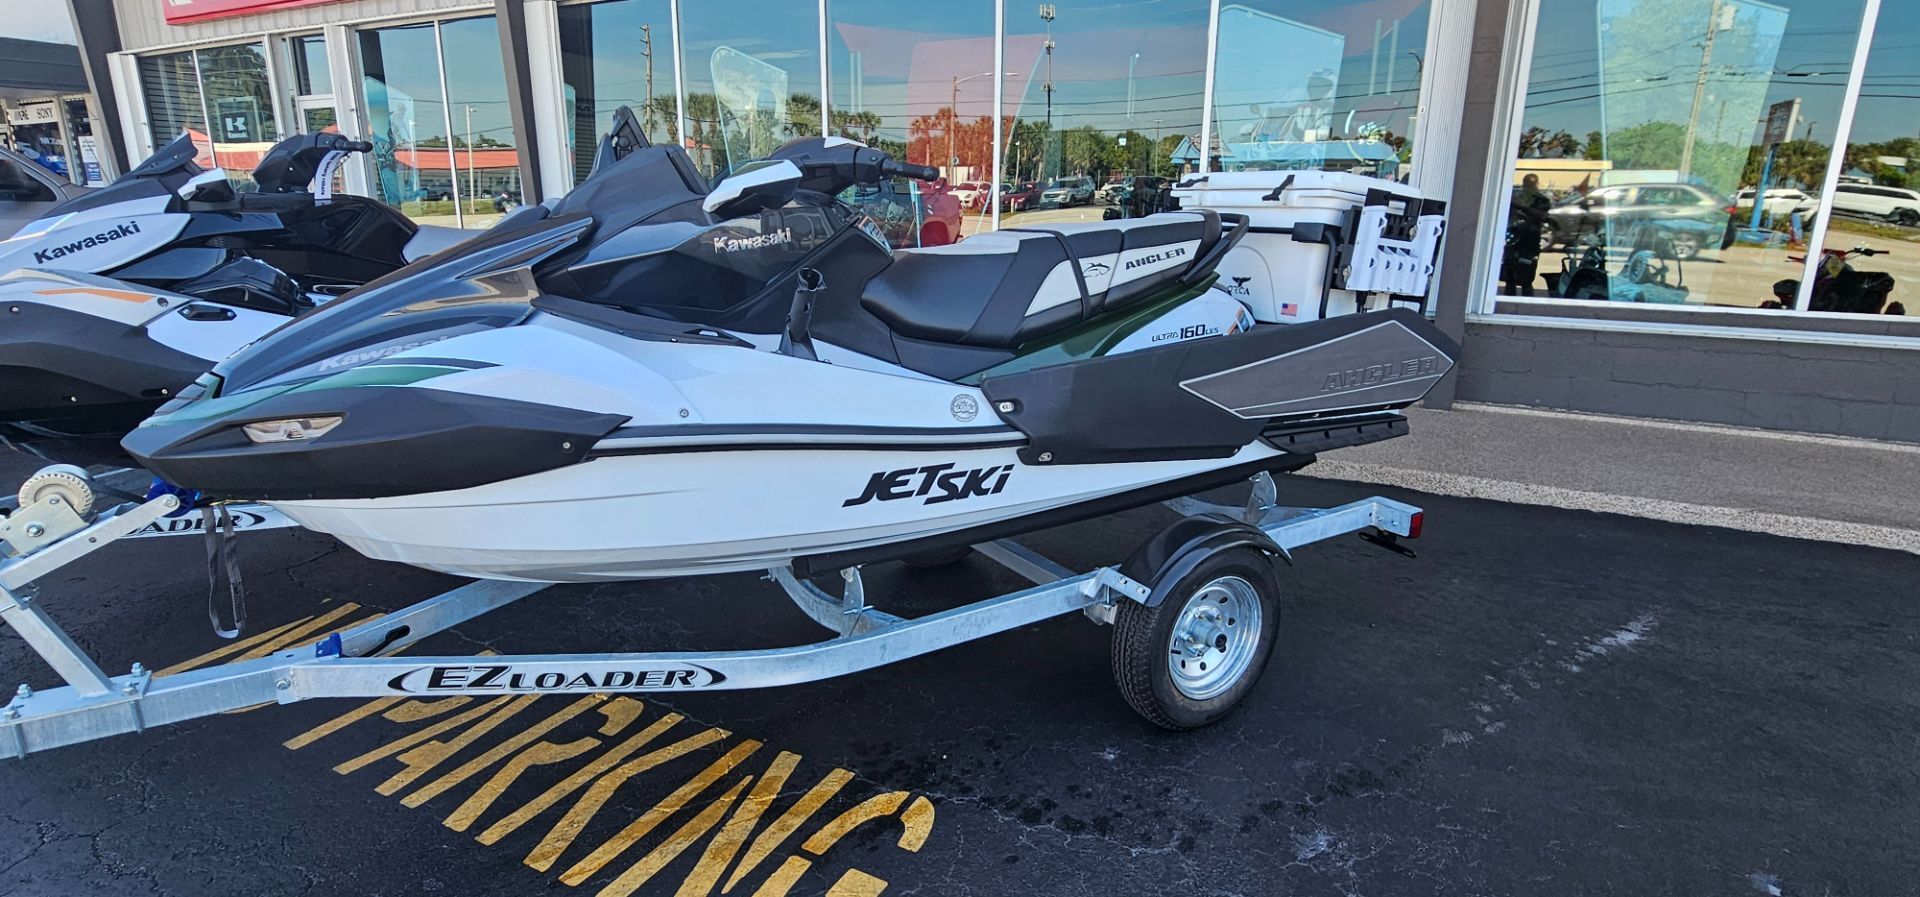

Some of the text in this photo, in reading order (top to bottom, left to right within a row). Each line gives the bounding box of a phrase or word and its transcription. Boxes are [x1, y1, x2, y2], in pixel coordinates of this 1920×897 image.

[33, 220, 141, 264] Kawasaki
[713, 227, 792, 254] Kawasaki
[1125, 247, 1186, 271] ANGLER
[1320, 356, 1440, 392] ANGLER
